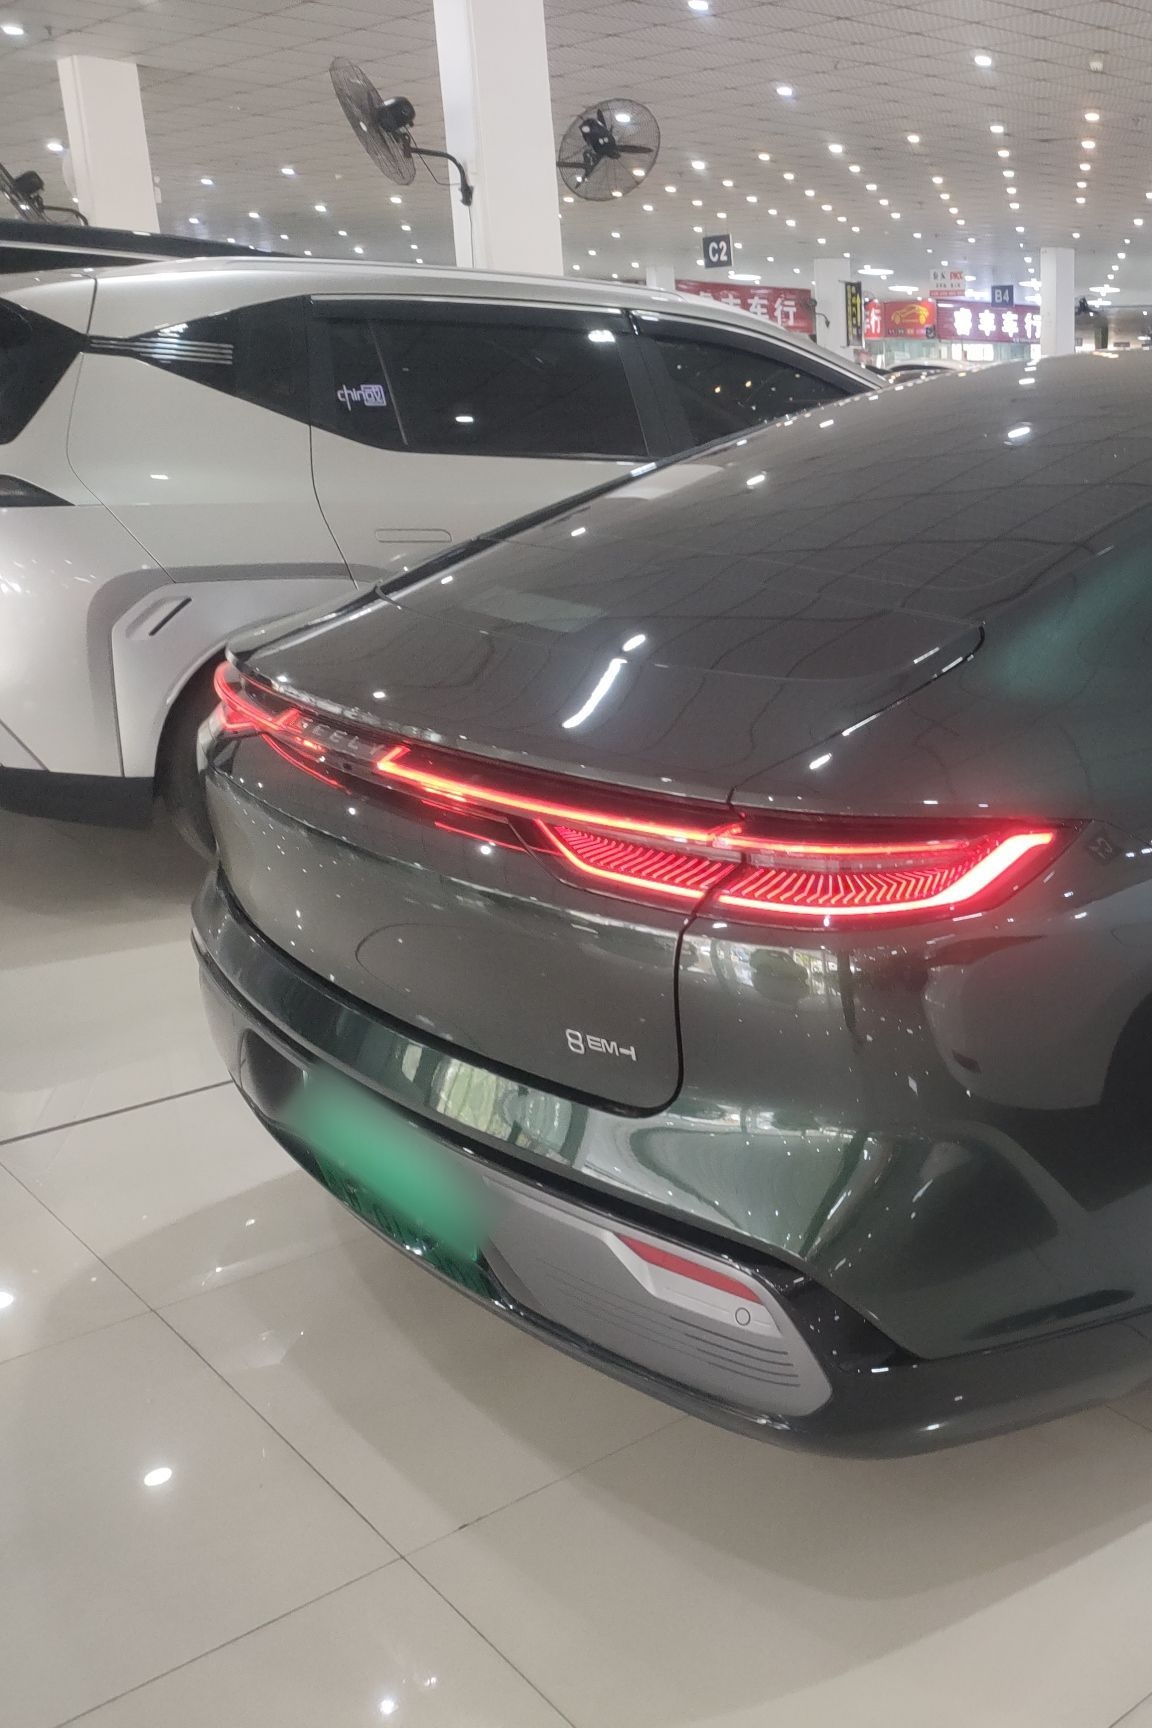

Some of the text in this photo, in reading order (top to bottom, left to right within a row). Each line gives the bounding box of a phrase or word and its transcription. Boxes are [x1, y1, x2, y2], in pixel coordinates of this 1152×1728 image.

[708, 240, 728, 262] C2
[994, 288, 1010, 303] B4
[565, 1028, 585, 1055] 8
